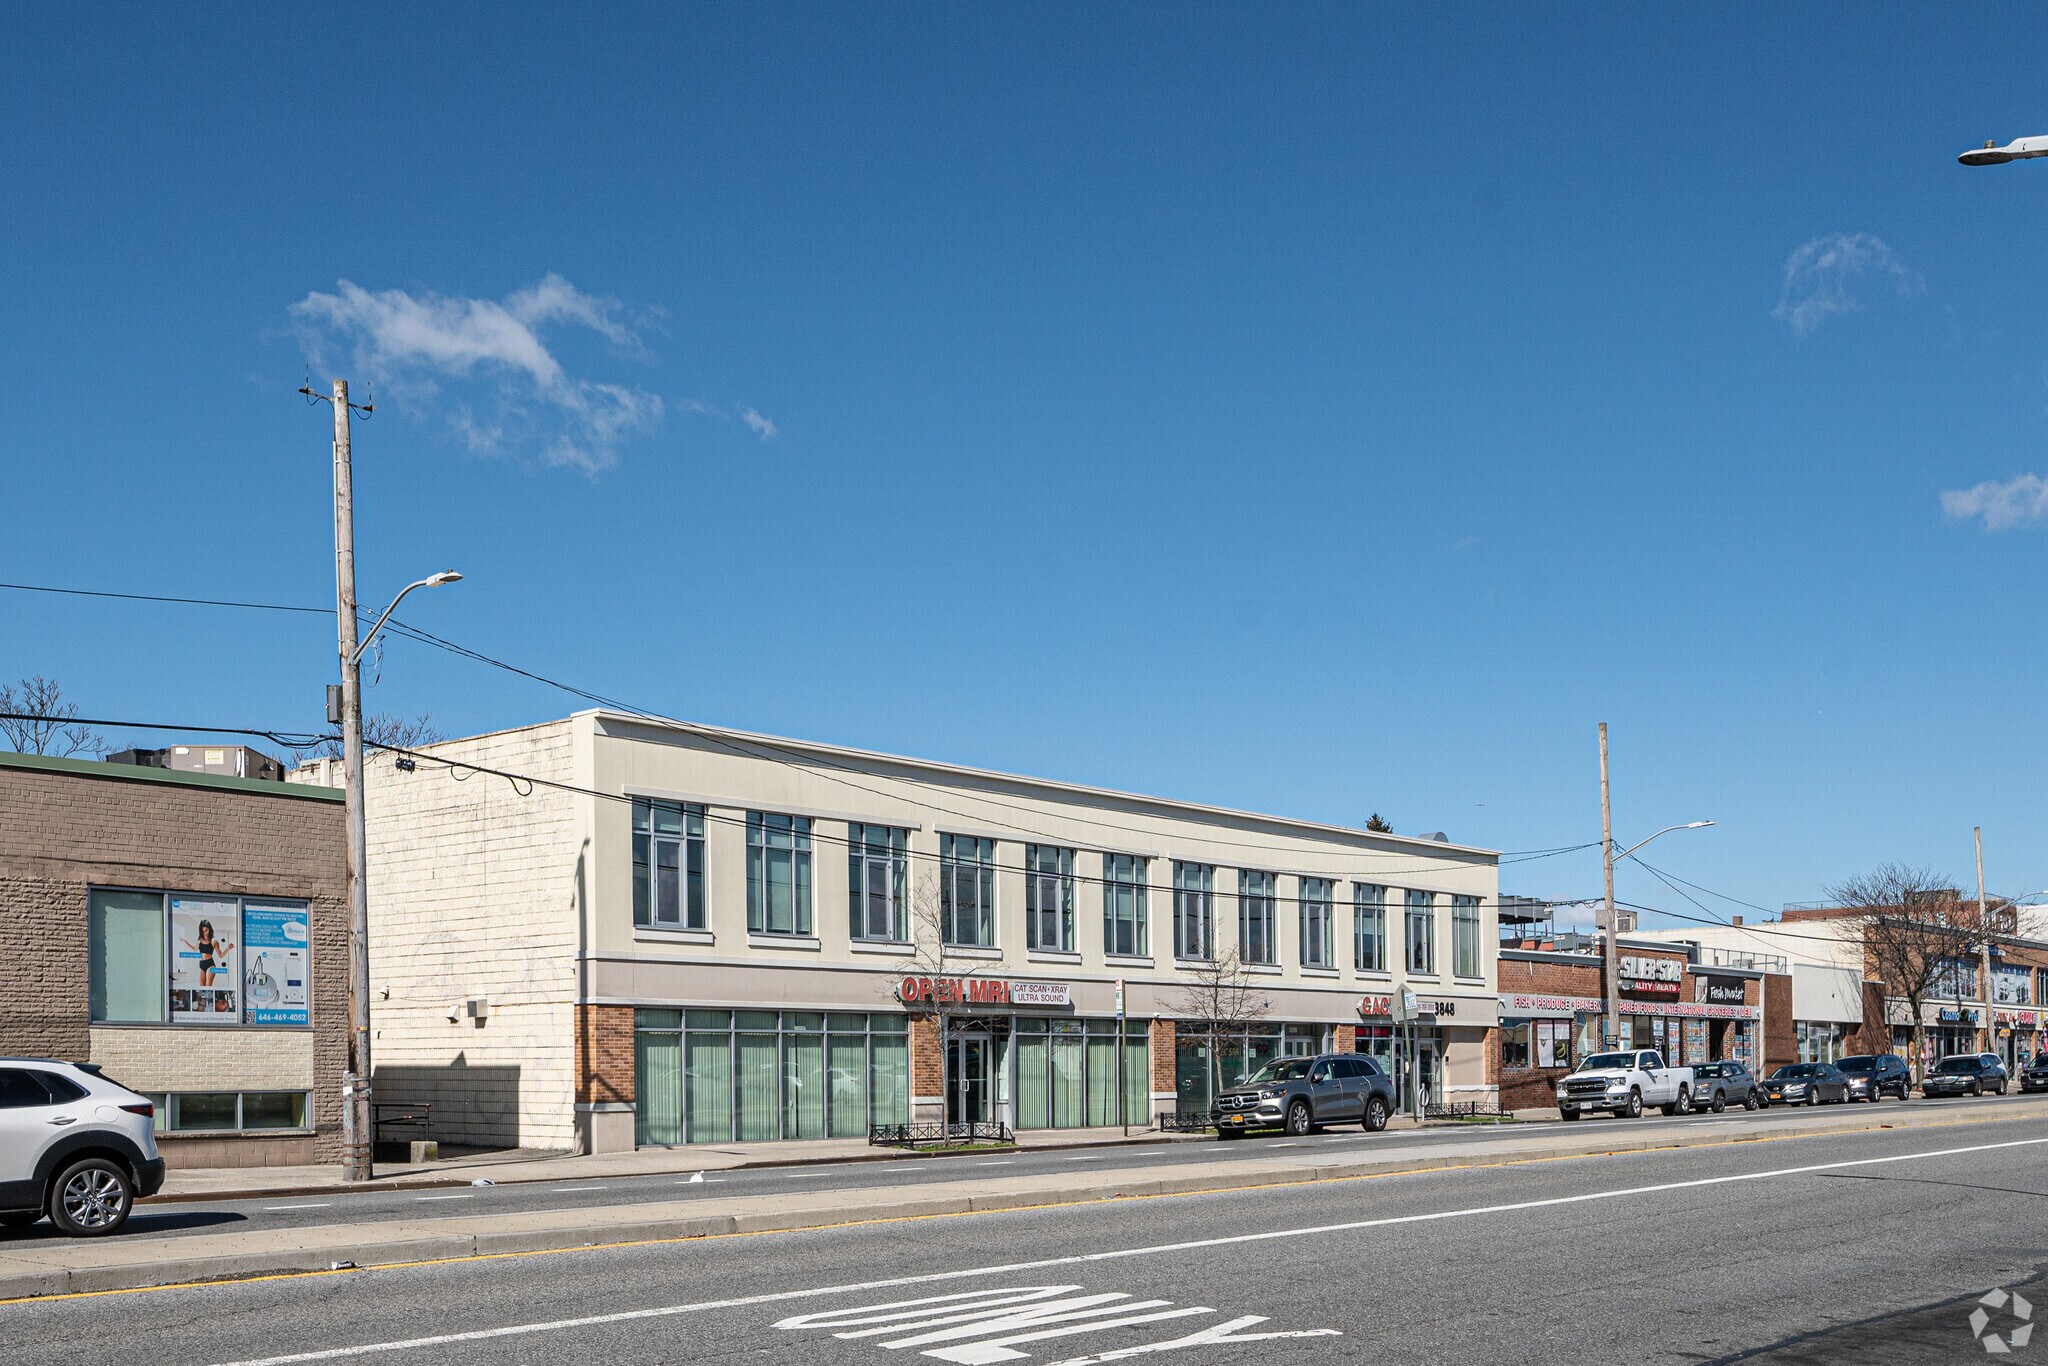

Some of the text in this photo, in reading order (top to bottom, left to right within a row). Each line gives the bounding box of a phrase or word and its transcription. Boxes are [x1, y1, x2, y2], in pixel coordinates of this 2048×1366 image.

[902, 976, 1009, 1003] OPEN MRI
[1014, 984, 1028, 993] CAT
[1018, 993, 1065, 1003] ULTRA SOUND
[1434, 1001, 1455, 1017] 3848
[1513, 995, 1531, 1009] FISH
[1536, 997, 1570, 1011] PRODUCE
[1640, 1002, 1660, 1015] FOODS
[1664, 1003, 1706, 1017] INTERNATIONAL
[1707, 1006, 1737, 1019] GROCERIES
[1740, 1007, 1752, 1019] DELI
[258, 1013, 307, 1022] 646-469-4052
